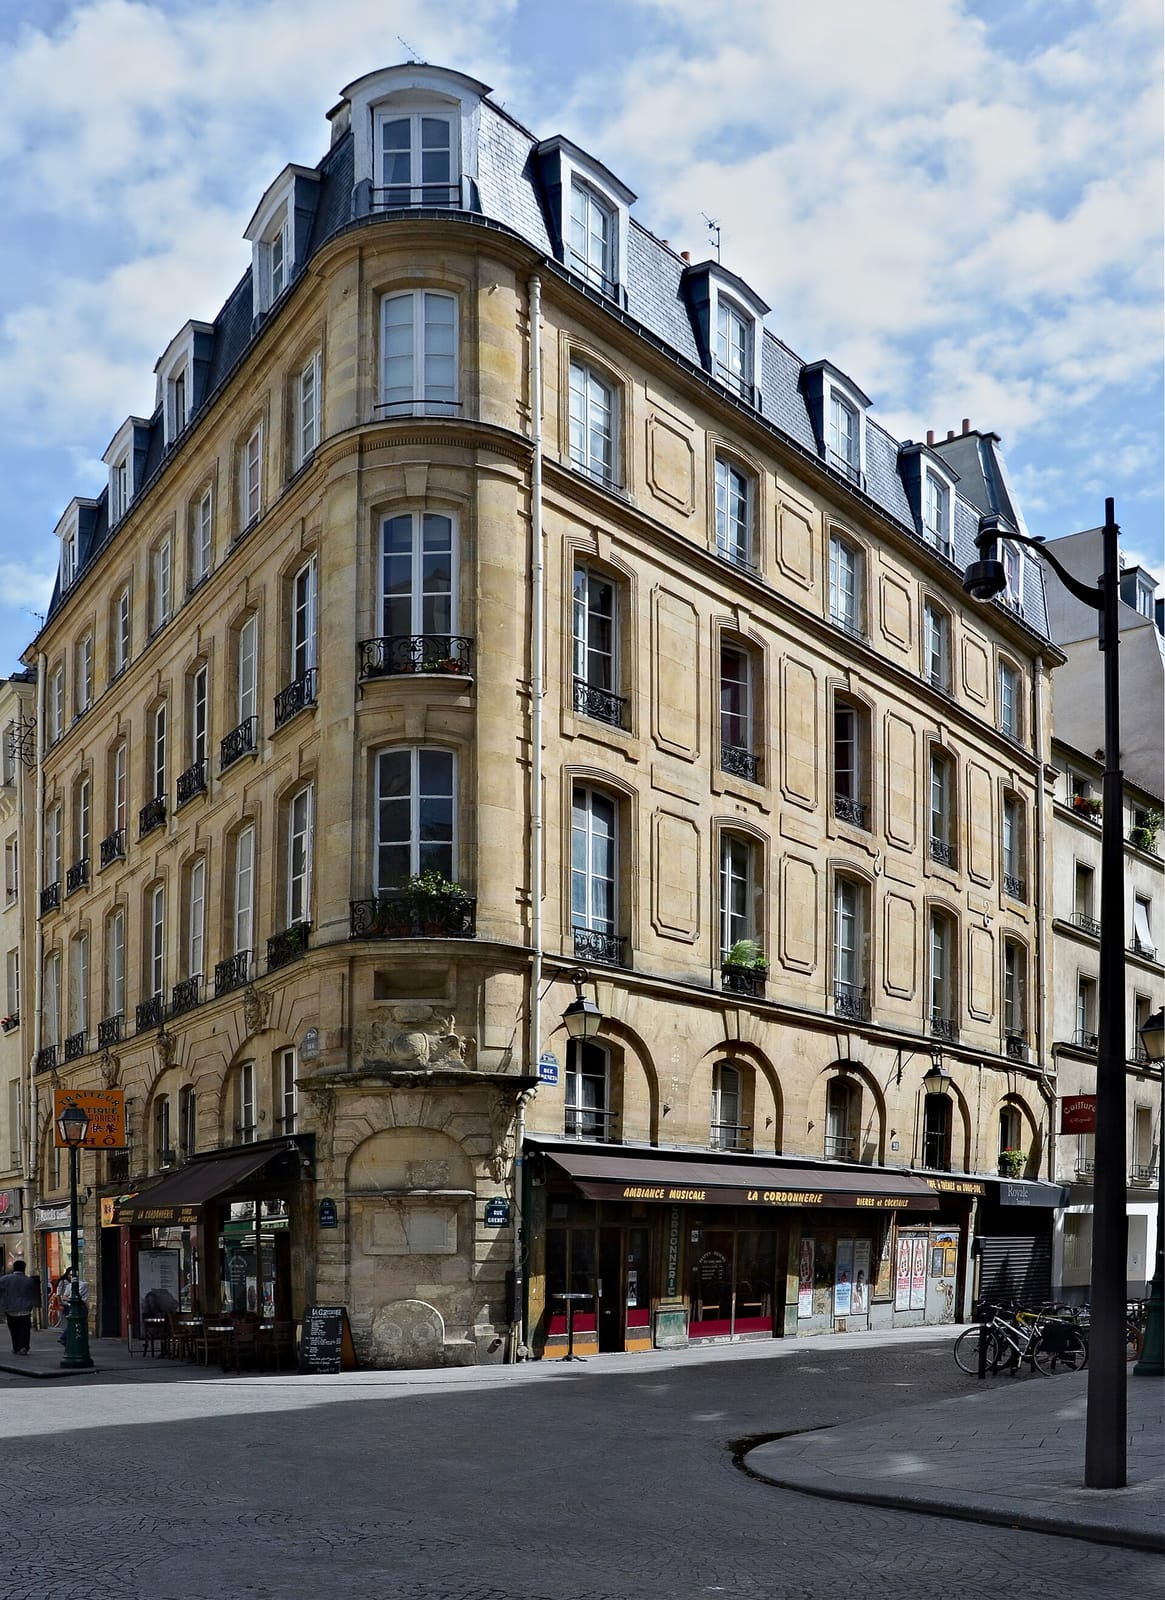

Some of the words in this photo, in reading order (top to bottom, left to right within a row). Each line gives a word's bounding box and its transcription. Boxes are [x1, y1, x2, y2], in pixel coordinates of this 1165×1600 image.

[58, 1091, 120, 1106] TRAITEUR
[1063, 1101, 1096, 1114] Coiffure
[66, 1135, 116, 1145] HÔ
[623, 1187, 665, 1199] AMBIANCE
[669, 1190, 706, 1200] MUSICALE
[747, 1191, 759, 1201] LA
[763, 1192, 824, 1203] CORDONNERIE
[884, 1199, 909, 1207] COCKTAILS
[1007, 1184, 1029, 1198] Royale
